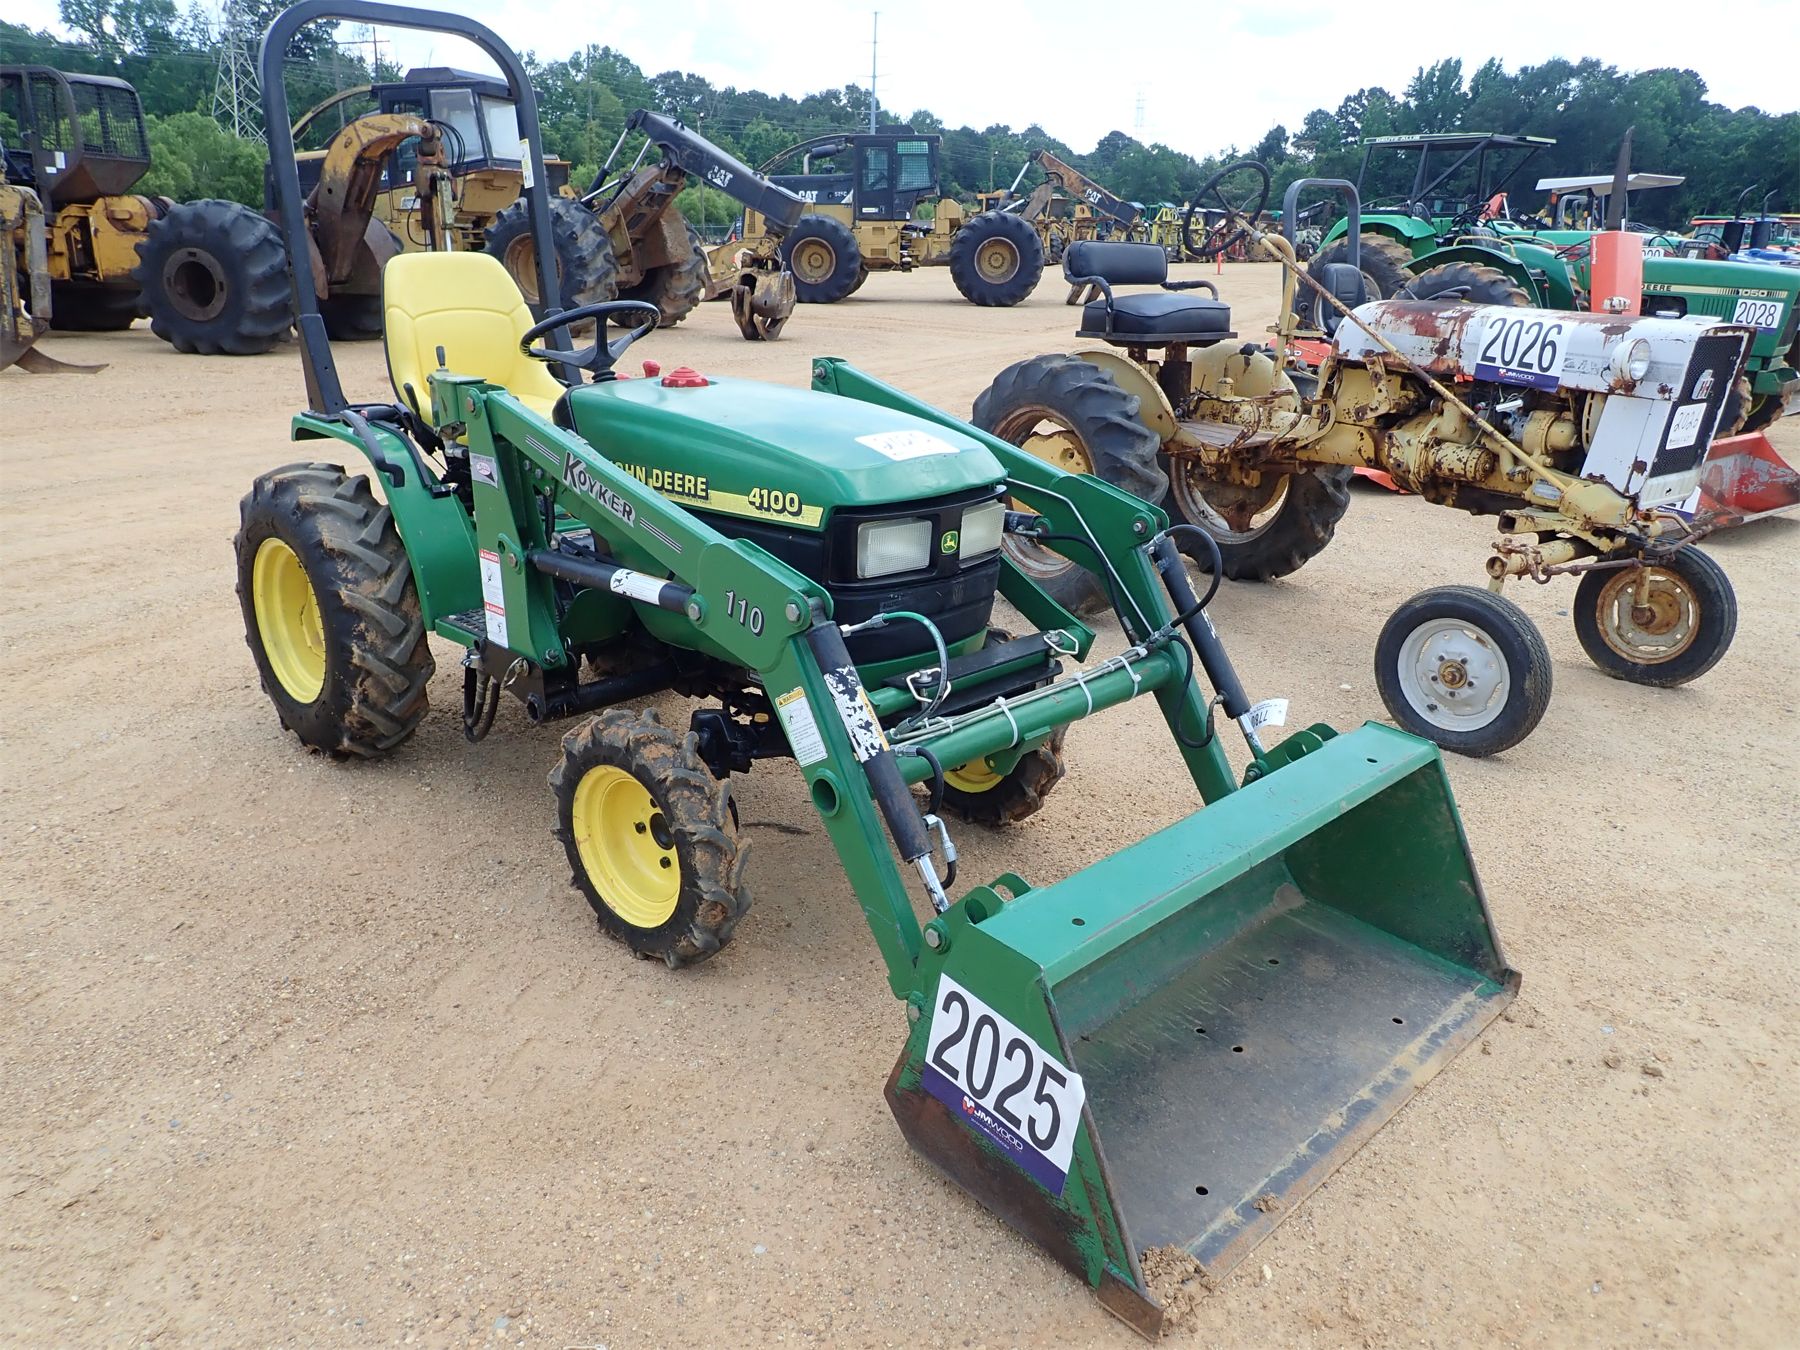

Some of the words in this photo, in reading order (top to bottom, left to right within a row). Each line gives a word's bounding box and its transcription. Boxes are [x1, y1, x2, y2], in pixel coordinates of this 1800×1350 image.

[707, 164, 734, 188] CAT
[798, 190, 818, 203] CAT
[1084, 188, 1102, 204] CAT
[1738, 288, 1768, 298] 1050
[1735, 301, 1777, 327] 2028
[1480, 317, 1563, 373] 2026
[652, 468, 708, 500] DEERE
[748, 487, 802, 516] 4100
[725, 589, 765, 637] 110
[931, 990, 1068, 1152] 2025
